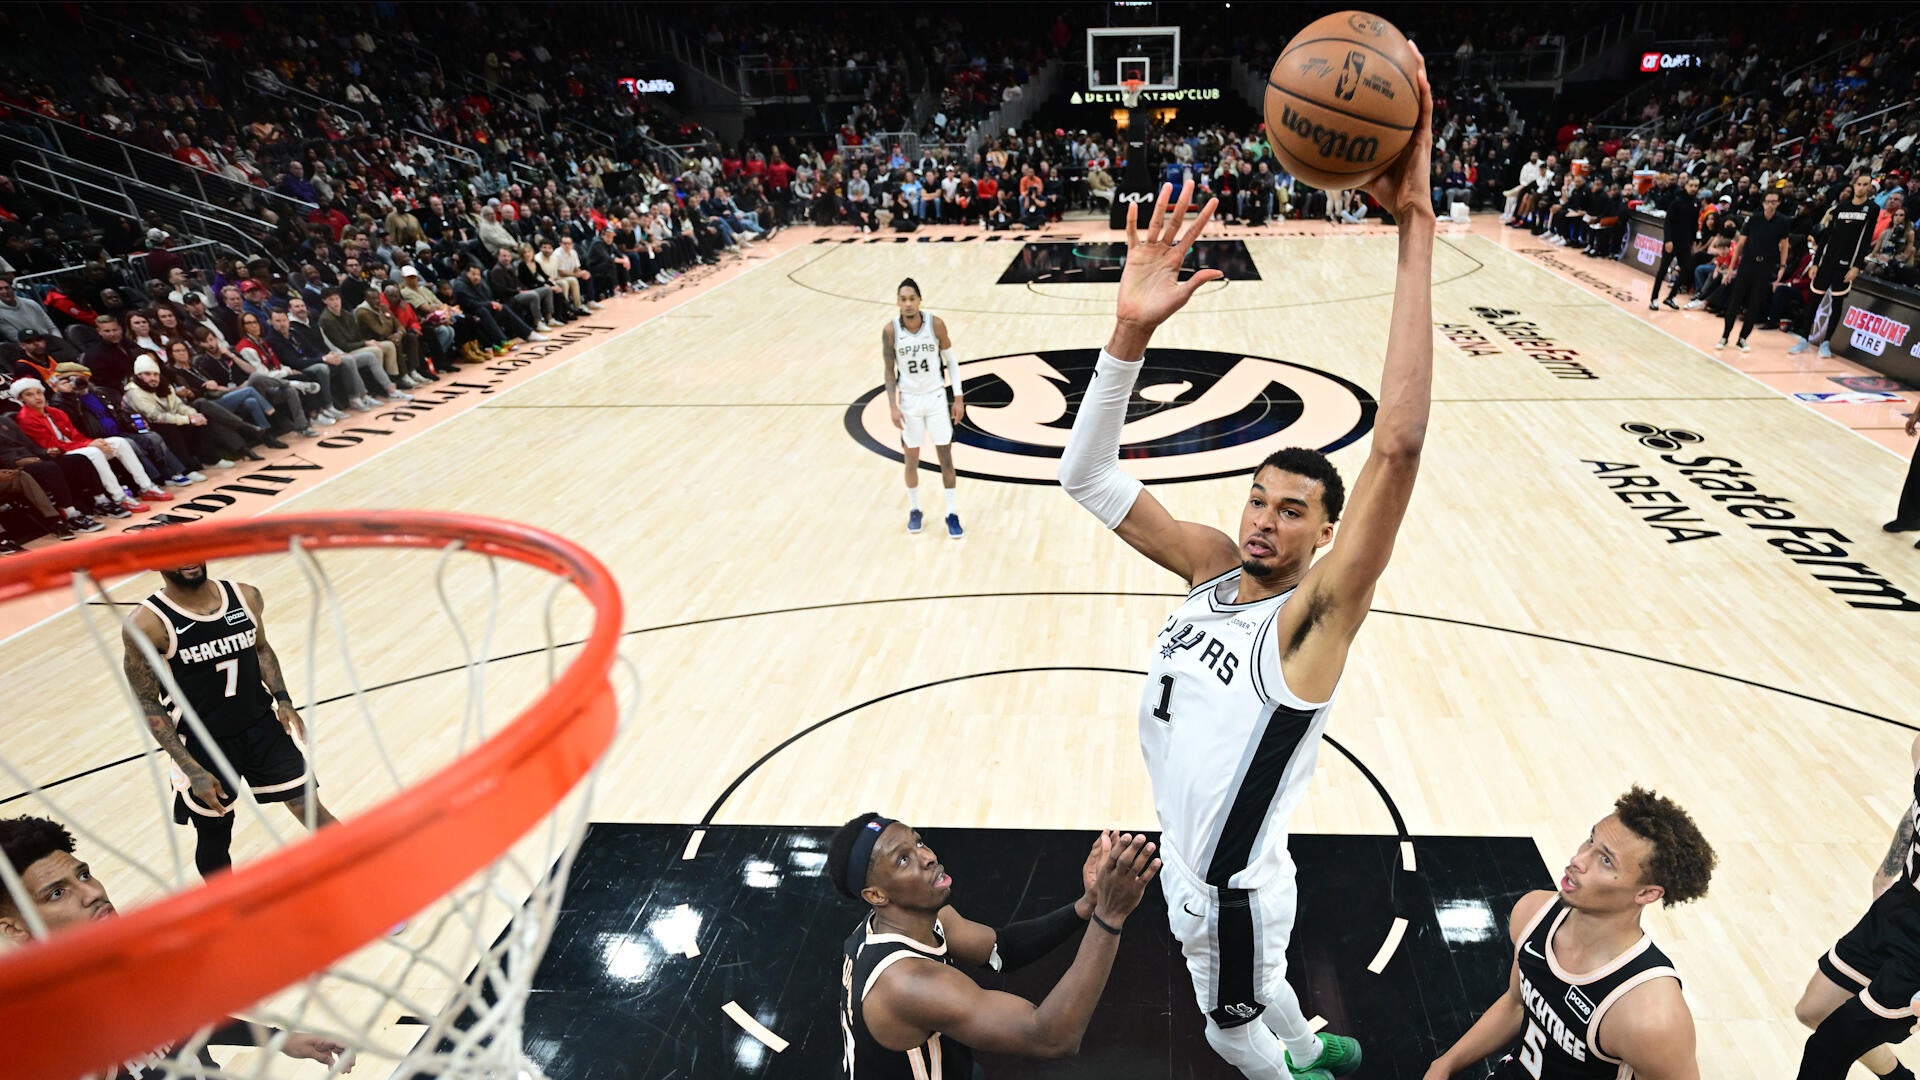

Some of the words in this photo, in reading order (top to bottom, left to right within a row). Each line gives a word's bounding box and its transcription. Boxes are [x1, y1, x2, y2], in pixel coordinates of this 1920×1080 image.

[1188, 88, 1220, 100] CLUB
[1281, 102, 1378, 162] Wilson
[1434, 322, 1503, 357] ARENA
[1844, 307, 1908, 345] DISCOUNT
[1855, 333, 1881, 352] TIRE
[899, 343, 935, 357] SPURS
[907, 359, 929, 374] 24
[315, 428, 395, 449] to
[122, 453, 324, 534] Atlan
[1580, 459, 1722, 544] ARENA
[226, 611, 245, 622] paze
[215, 658, 239, 698] 7
[1152, 674, 1176, 726] 1
[1568, 991, 1591, 1016] paze
[1519, 1016, 1547, 1080] 5
